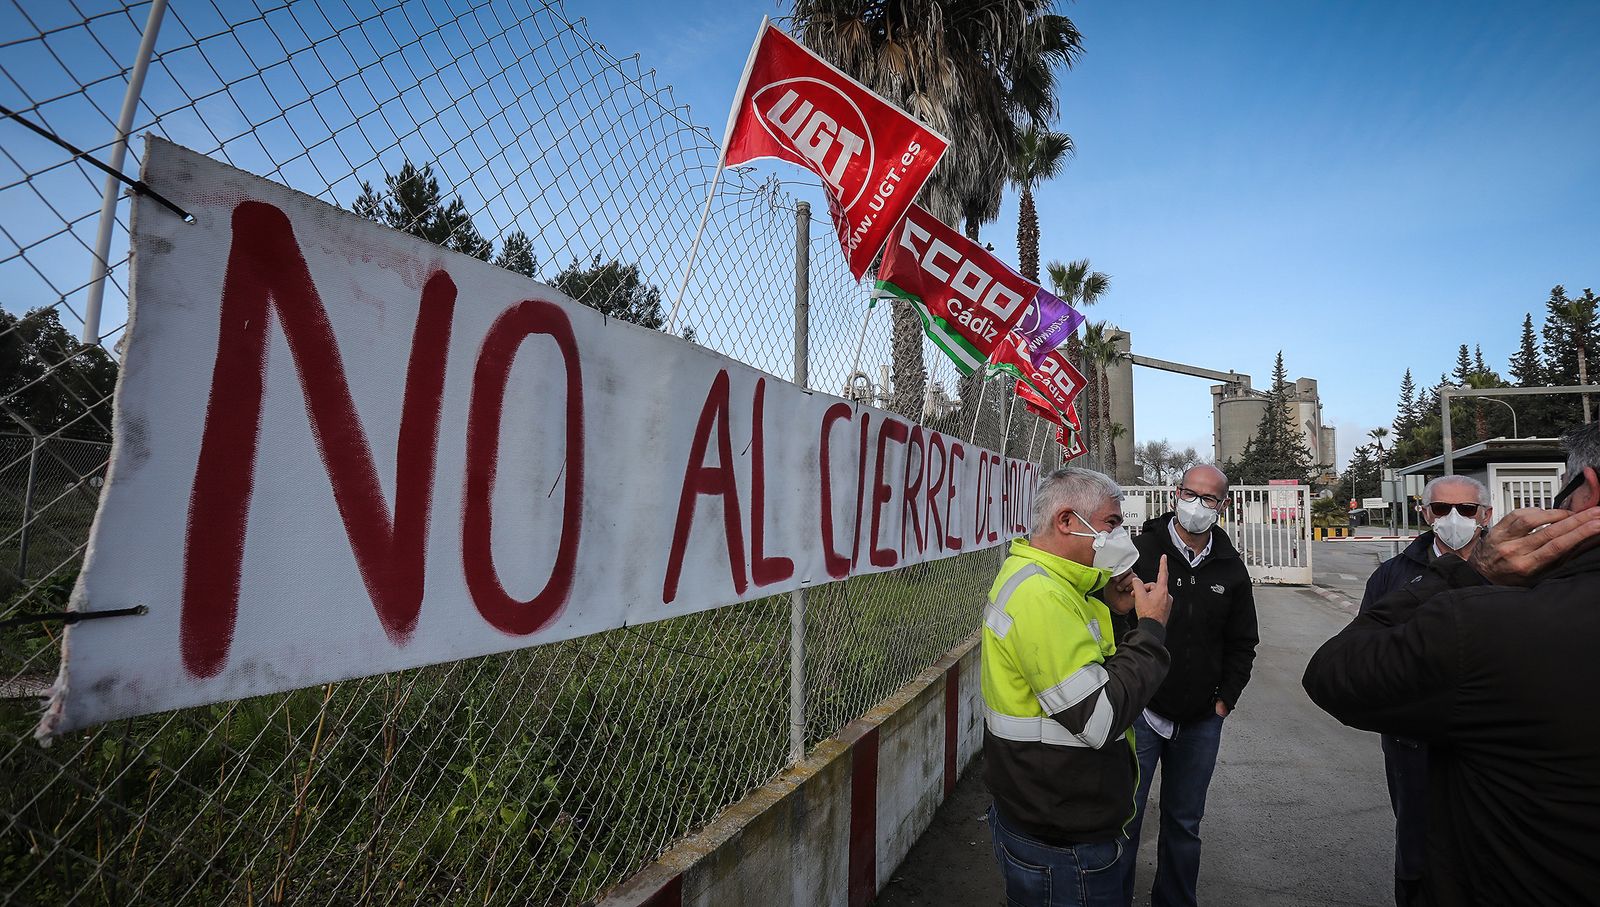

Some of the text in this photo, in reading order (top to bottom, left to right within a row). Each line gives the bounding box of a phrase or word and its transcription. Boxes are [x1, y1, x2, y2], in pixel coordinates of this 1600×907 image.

[766, 89, 865, 201] UGT
[848, 141, 921, 250] ww.UGT.es
[899, 217, 1025, 322] CCOO
[946, 298, 998, 343] Cádiz
[180, 200, 584, 680] NO
[662, 368, 795, 604] AL
[819, 403, 964, 580] CIERRE
[975, 451, 1000, 544] DE
[1031, 372, 1066, 404] Cádiz
